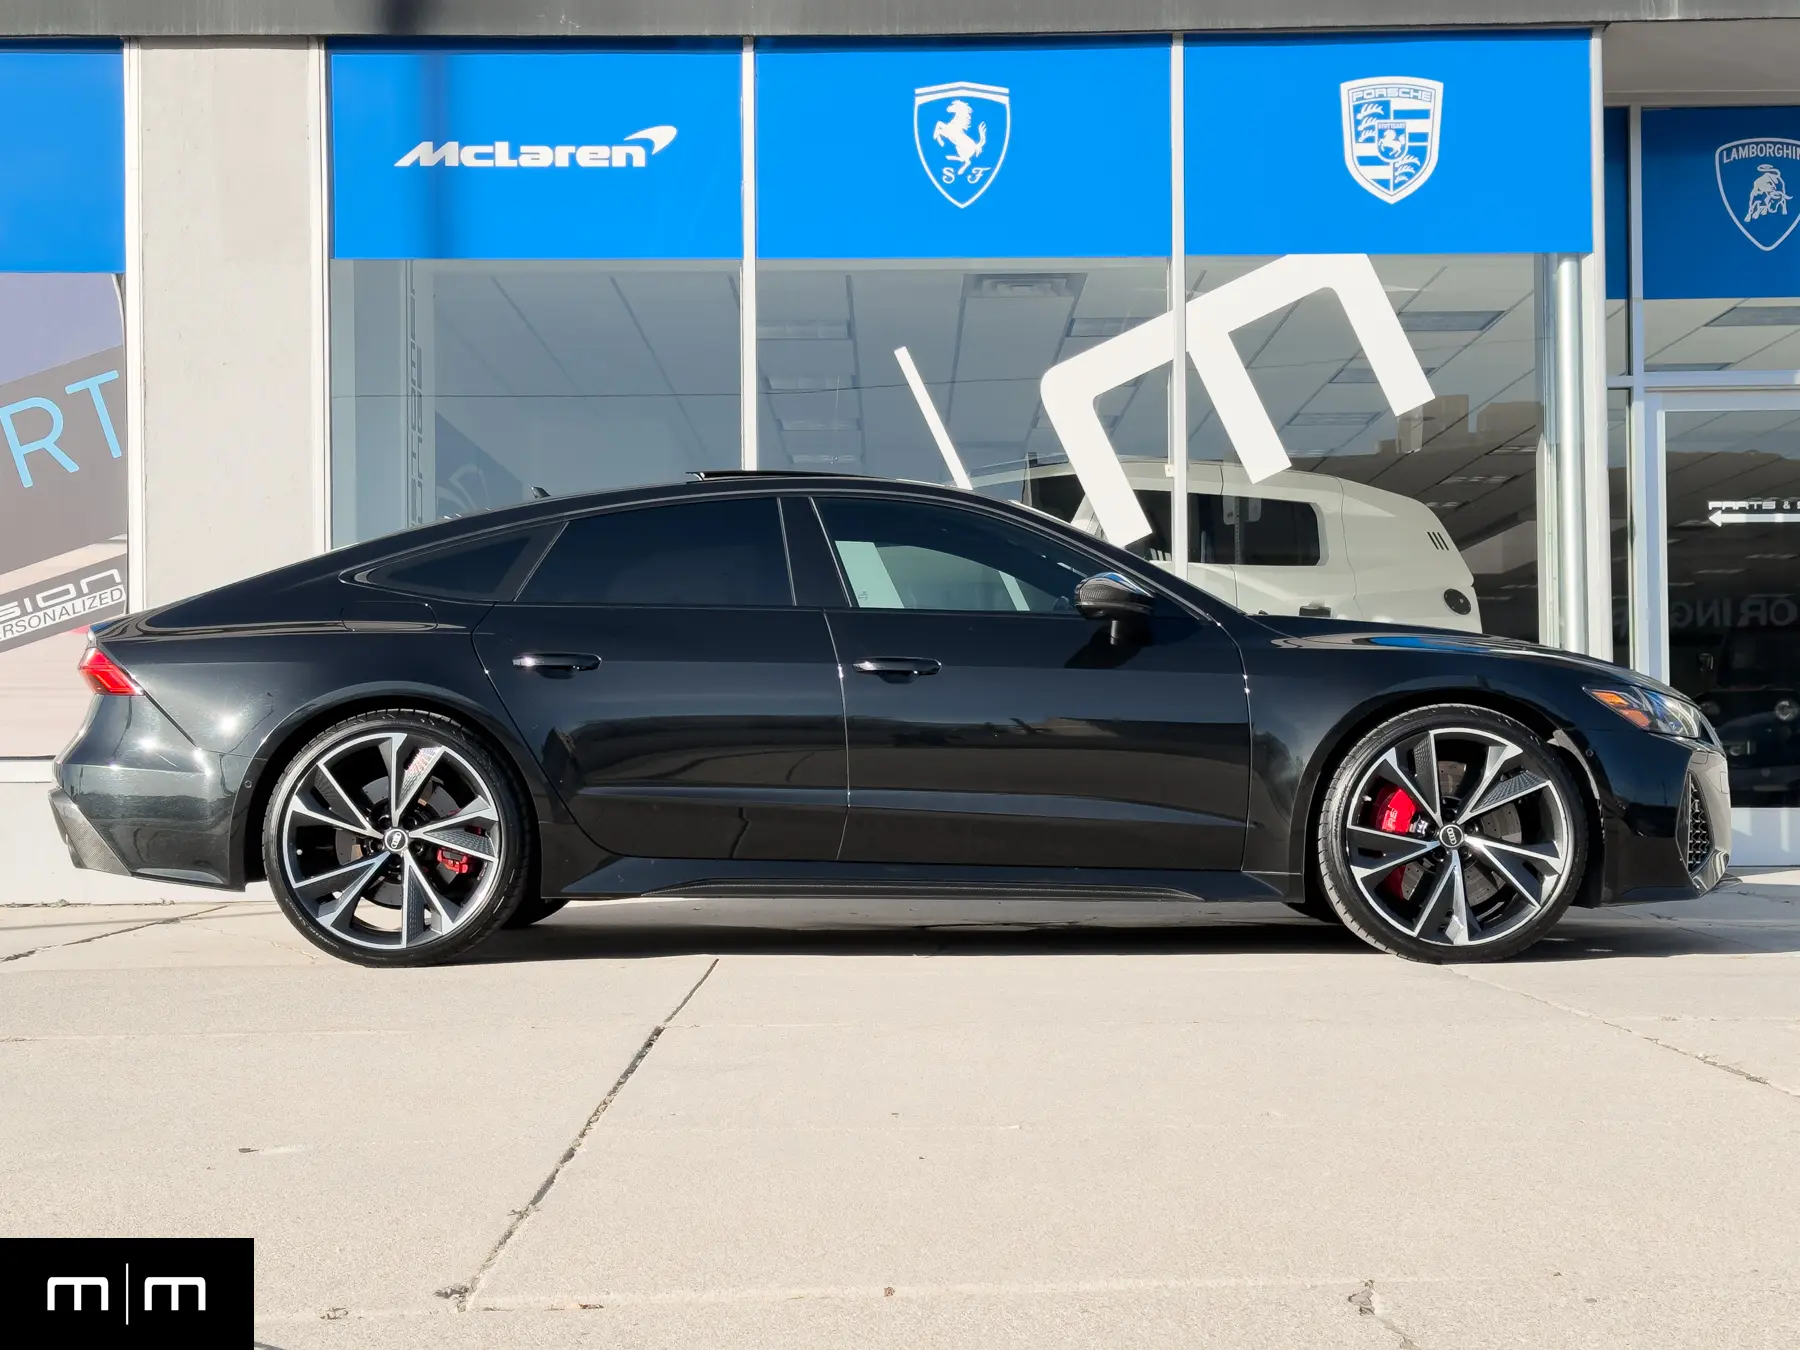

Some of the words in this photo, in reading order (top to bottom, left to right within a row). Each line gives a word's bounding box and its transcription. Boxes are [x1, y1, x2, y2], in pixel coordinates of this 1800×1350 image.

[1353, 87, 1432, 102] PORSCHE
[394, 141, 646, 167] McLaren
[1708, 501, 1776, 510] PARTS
[1783, 501, 1791, 509] &
[0, 587, 124, 639] RSONALIZED
